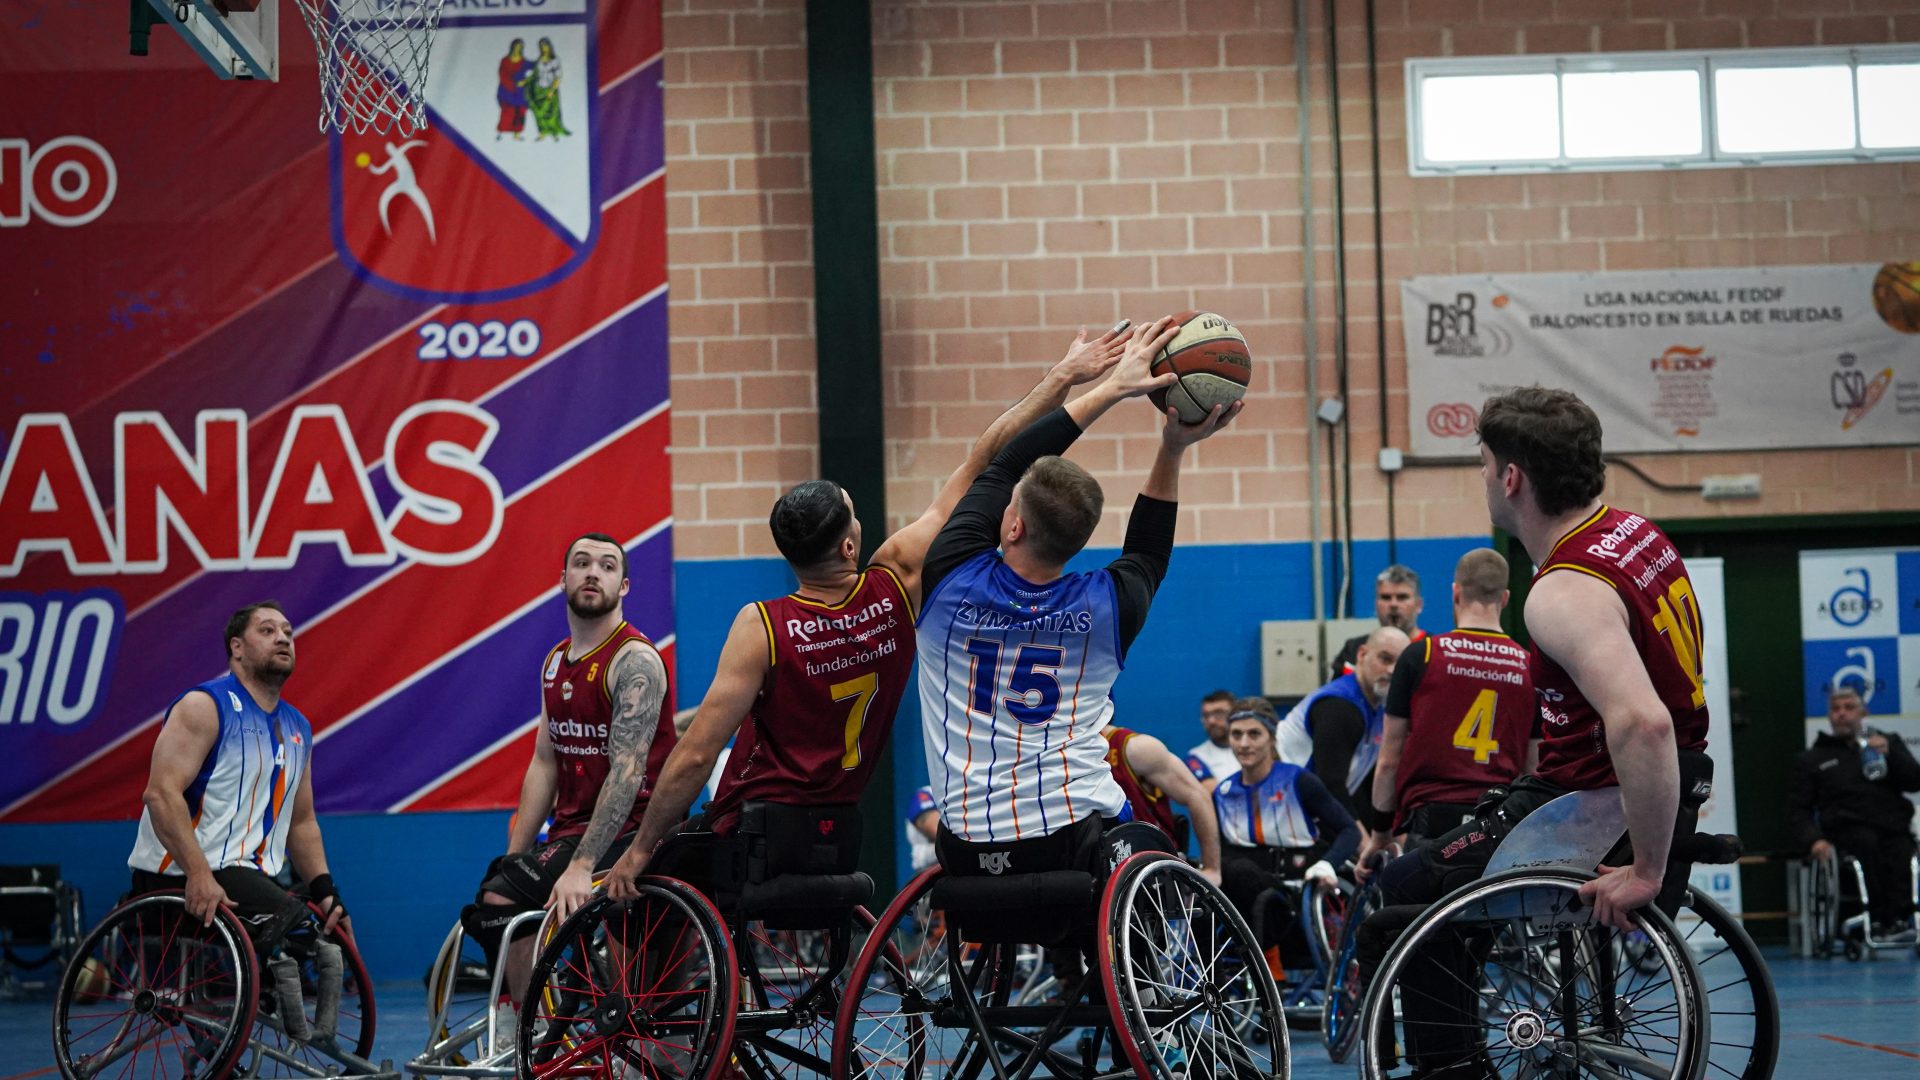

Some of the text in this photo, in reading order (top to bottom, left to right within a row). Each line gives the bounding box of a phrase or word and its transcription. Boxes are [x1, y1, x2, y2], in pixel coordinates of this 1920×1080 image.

[1584, 286, 1786, 307] LIGA NACIONAL FEDDF
[1529, 305, 1843, 329] BALONCESTO EN SILLA DE RUEDAS
[418, 320, 541, 360] 2020
[786, 597, 894, 642] Rehatrans
[957, 600, 1092, 633] ZYMANTAS
[795, 623, 888, 653] Transporte Adaptado
[1439, 636, 1526, 660] Rehatrans
[1653, 576, 1706, 710] 10
[587, 662, 599, 682] 5
[805, 637, 898, 677] fundaciónfdi
[1446, 663, 1524, 685] fundaciónfdi
[965, 636, 1067, 726] 15
[829, 671, 880, 771] 7
[1452, 688, 1500, 765] 4
